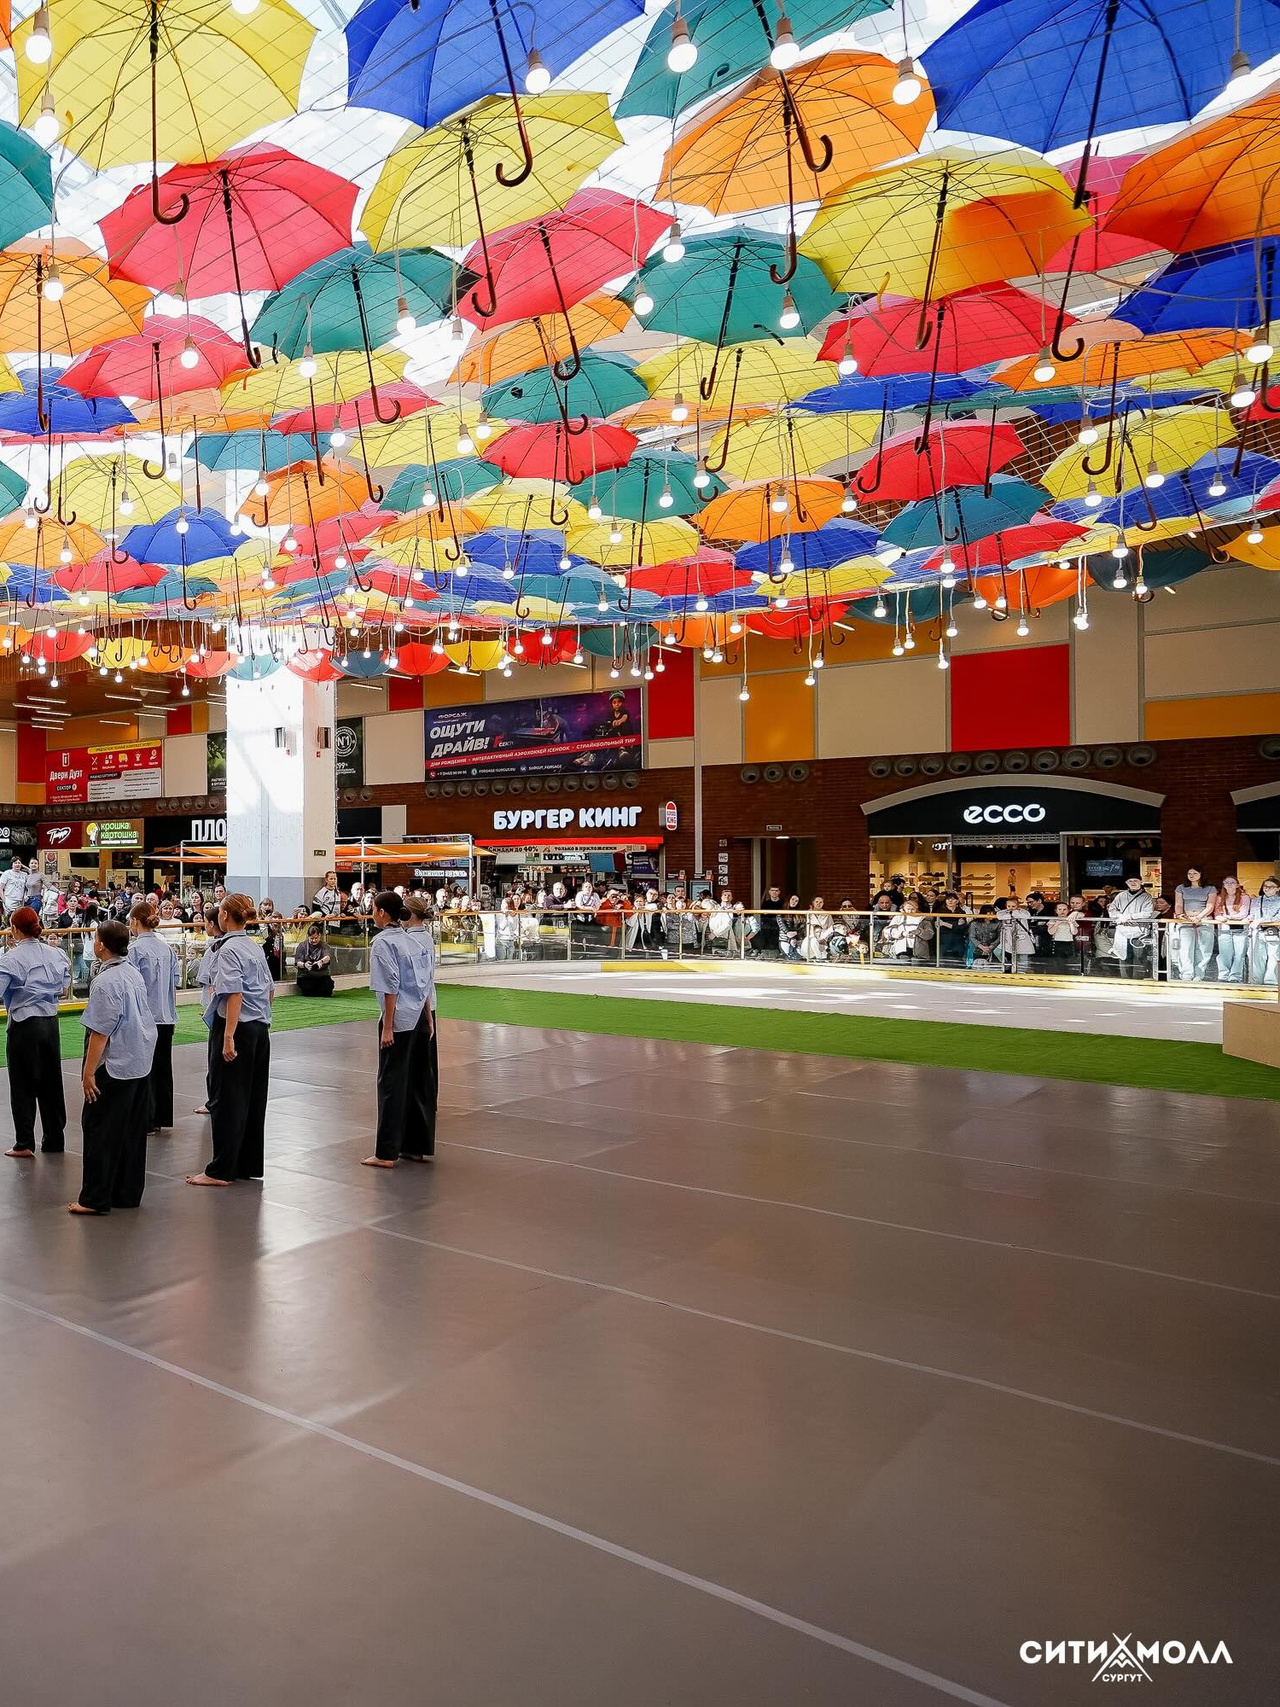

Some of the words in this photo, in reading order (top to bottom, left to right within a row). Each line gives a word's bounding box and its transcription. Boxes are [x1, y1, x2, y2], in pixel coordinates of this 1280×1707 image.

[429, 719, 486, 739] ОЩУТИ
[430, 736, 490, 758] ДРАЙВ!
[49, 770, 69, 782] Двери
[69, 769, 83, 780] Дуэт
[493, 808, 575, 830] БУРГЕР
[579, 806, 642, 828] КИНГ
[100, 822, 130, 831] крошка
[100, 831, 138, 841] картошка
